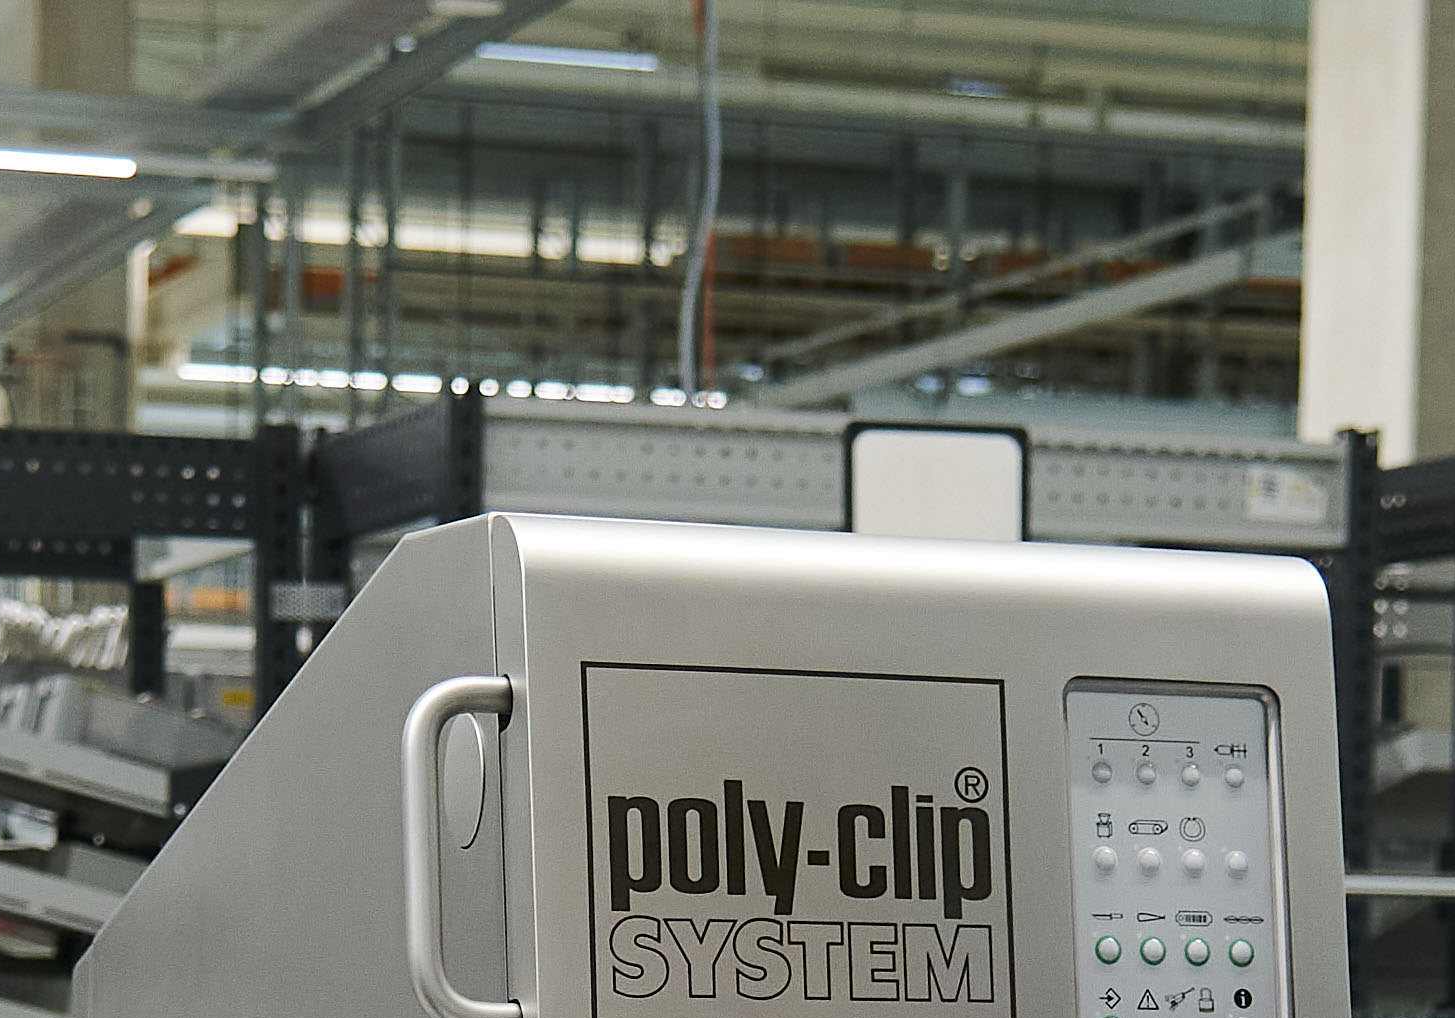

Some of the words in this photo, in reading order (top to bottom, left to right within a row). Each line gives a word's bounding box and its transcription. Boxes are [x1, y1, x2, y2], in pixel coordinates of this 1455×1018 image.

[1141, 744, 1150, 757] 2
[1185, 745, 1194, 759] 3
[609, 914, 995, 1003] SYSTEM
